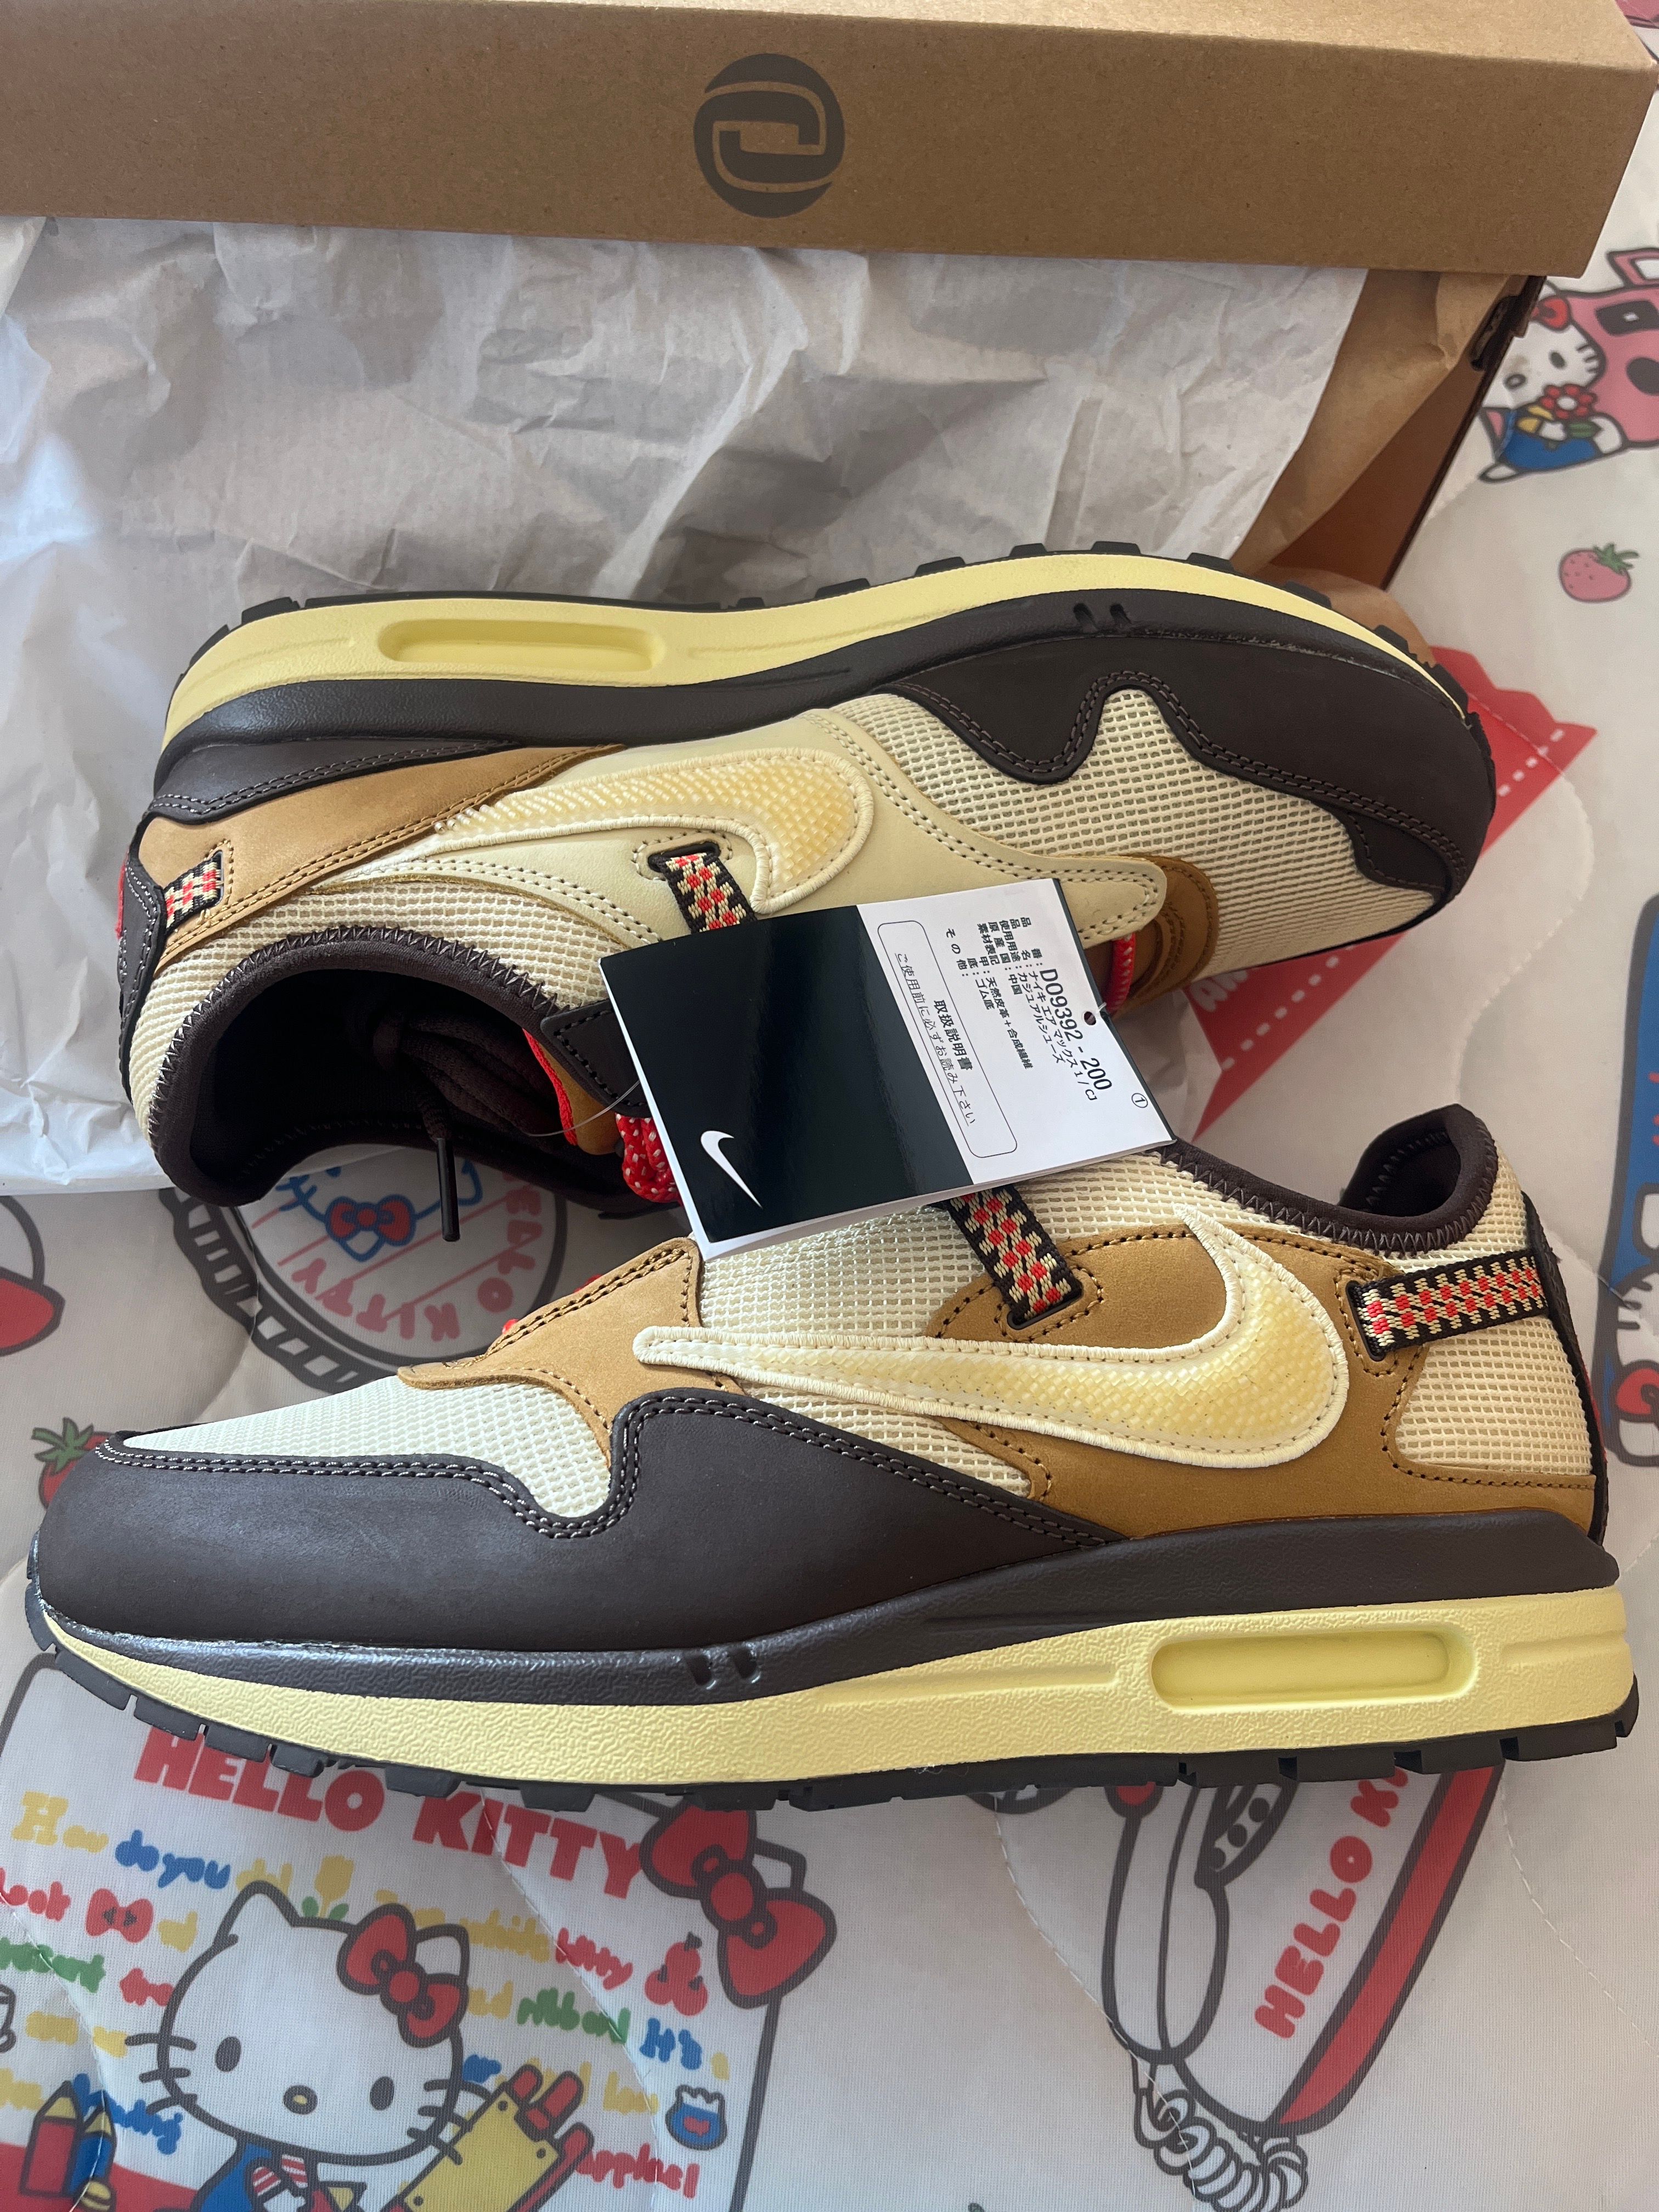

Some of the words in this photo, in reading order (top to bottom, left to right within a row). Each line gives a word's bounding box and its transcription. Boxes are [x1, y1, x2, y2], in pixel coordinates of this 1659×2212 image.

[975, 978, 995, 1009] ゴム底
[1008, 974, 1023, 995] 中国
[895, 952, 975, 1124] ご使用前に必ずお読み下さい
[933, 999, 973, 1070] 取扱説明書
[1080, 1058, 1112, 1090] 200
[477, 1172, 543, 1313] ELLO
[291, 1257, 461, 1341] KITTY
[134, 1726, 386, 1832] HELLO
[413, 1790, 641, 1899] KITTY
[1254, 1835, 1373, 2039] HELLO
